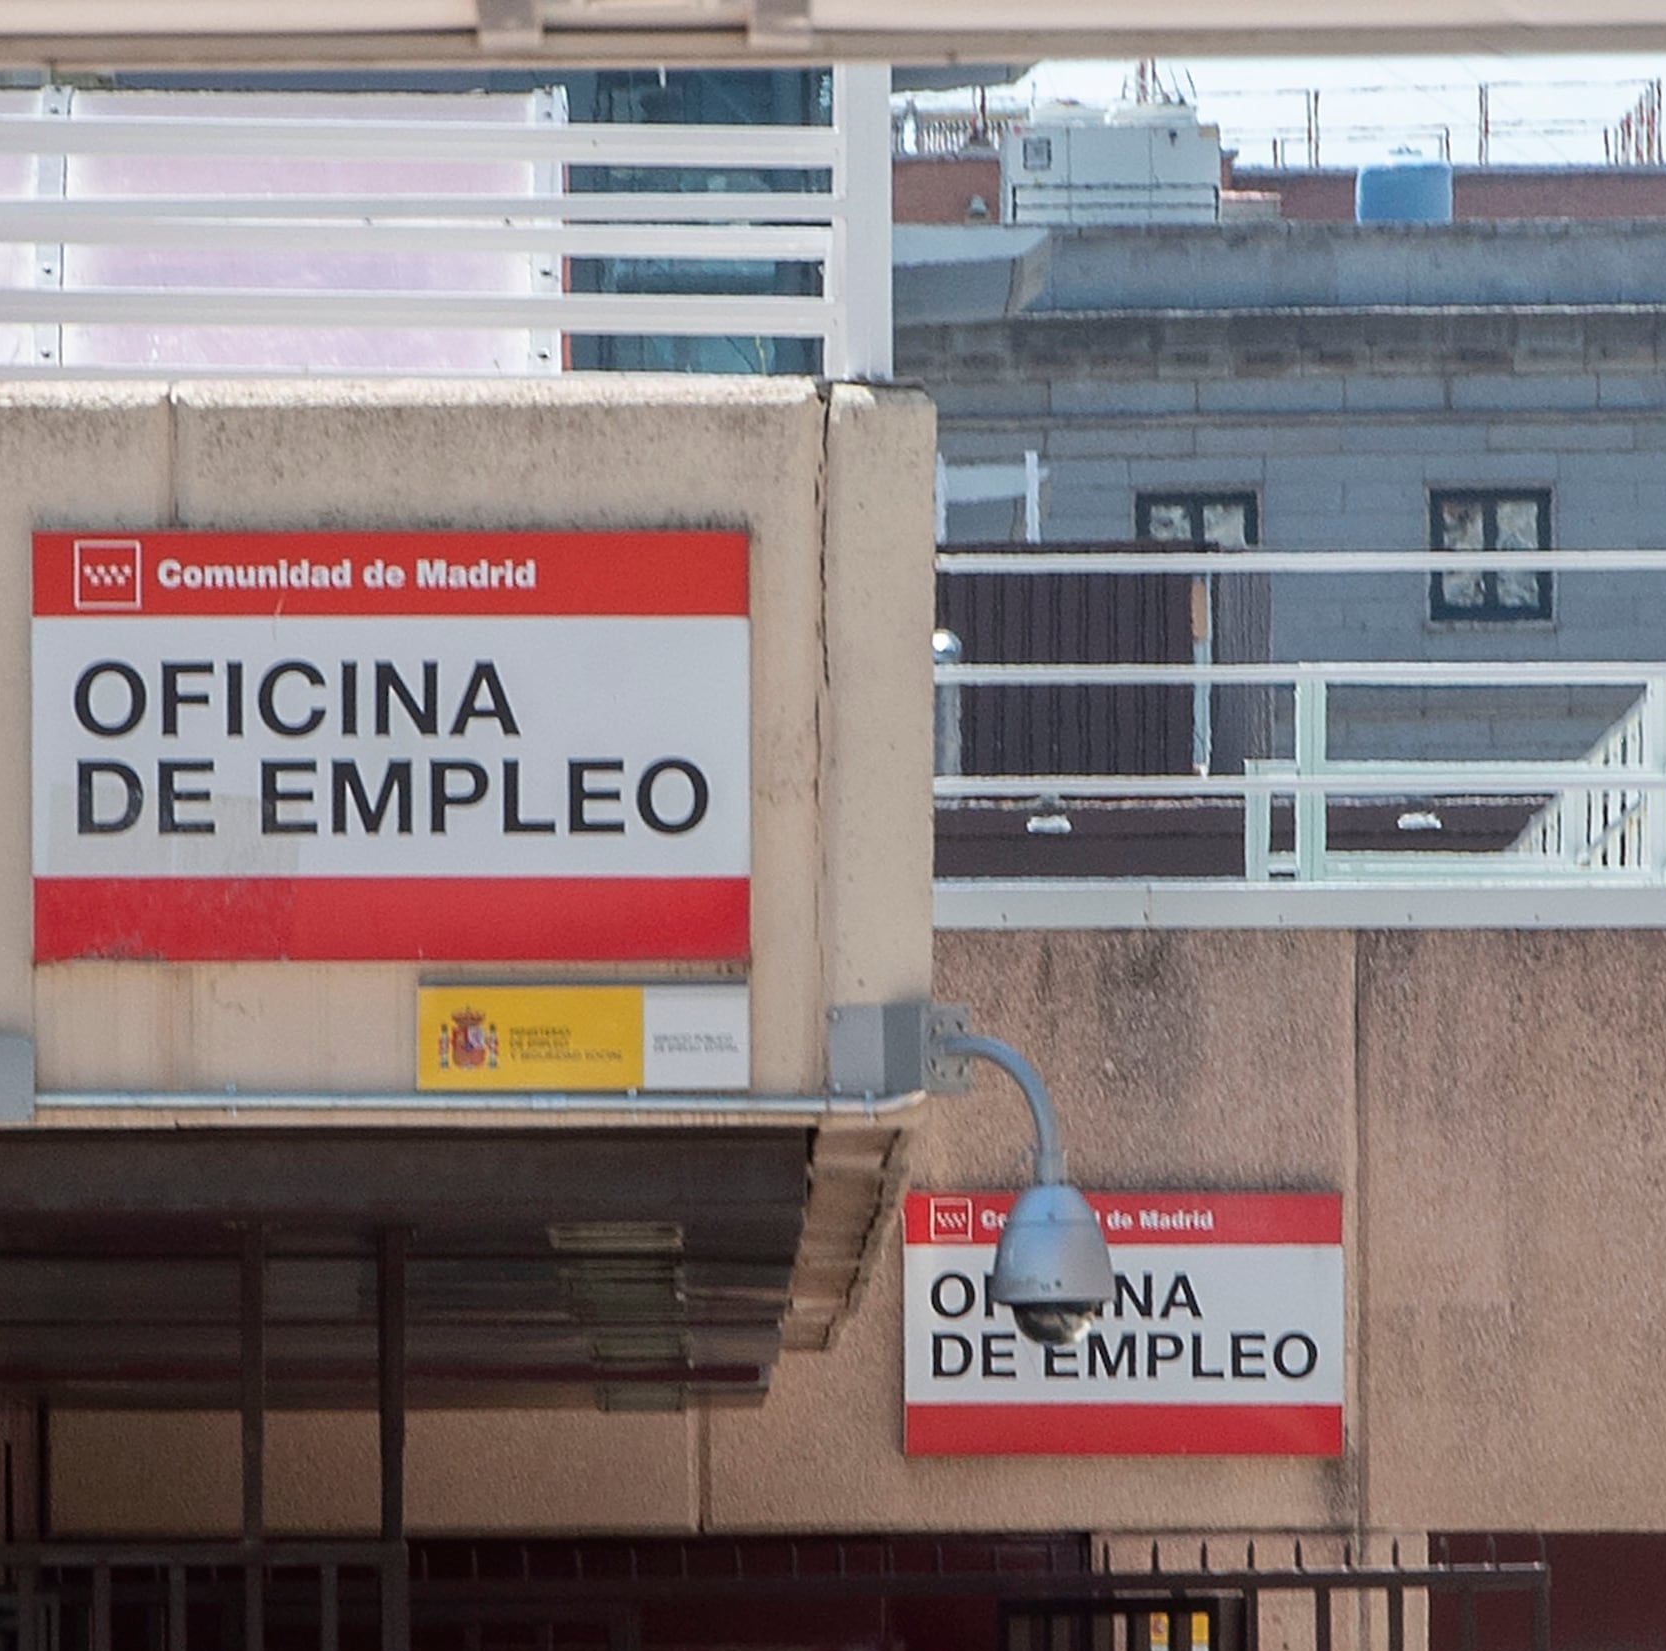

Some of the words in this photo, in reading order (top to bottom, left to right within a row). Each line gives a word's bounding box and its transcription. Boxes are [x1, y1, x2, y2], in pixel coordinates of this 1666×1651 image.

[156, 558, 352, 589] Comunidad
[362, 558, 406, 589] de
[416, 558, 537, 589] Madrid
[73, 660, 521, 737] OFICINA
[76, 760, 217, 836] DE
[260, 758, 711, 836] EMPLEO
[1106, 1209, 1134, 1231] de
[1138, 1208, 1215, 1231] Madrid
[931, 1333, 1017, 1379] DE
[1044, 1333, 1319, 1379] EMPLEO
